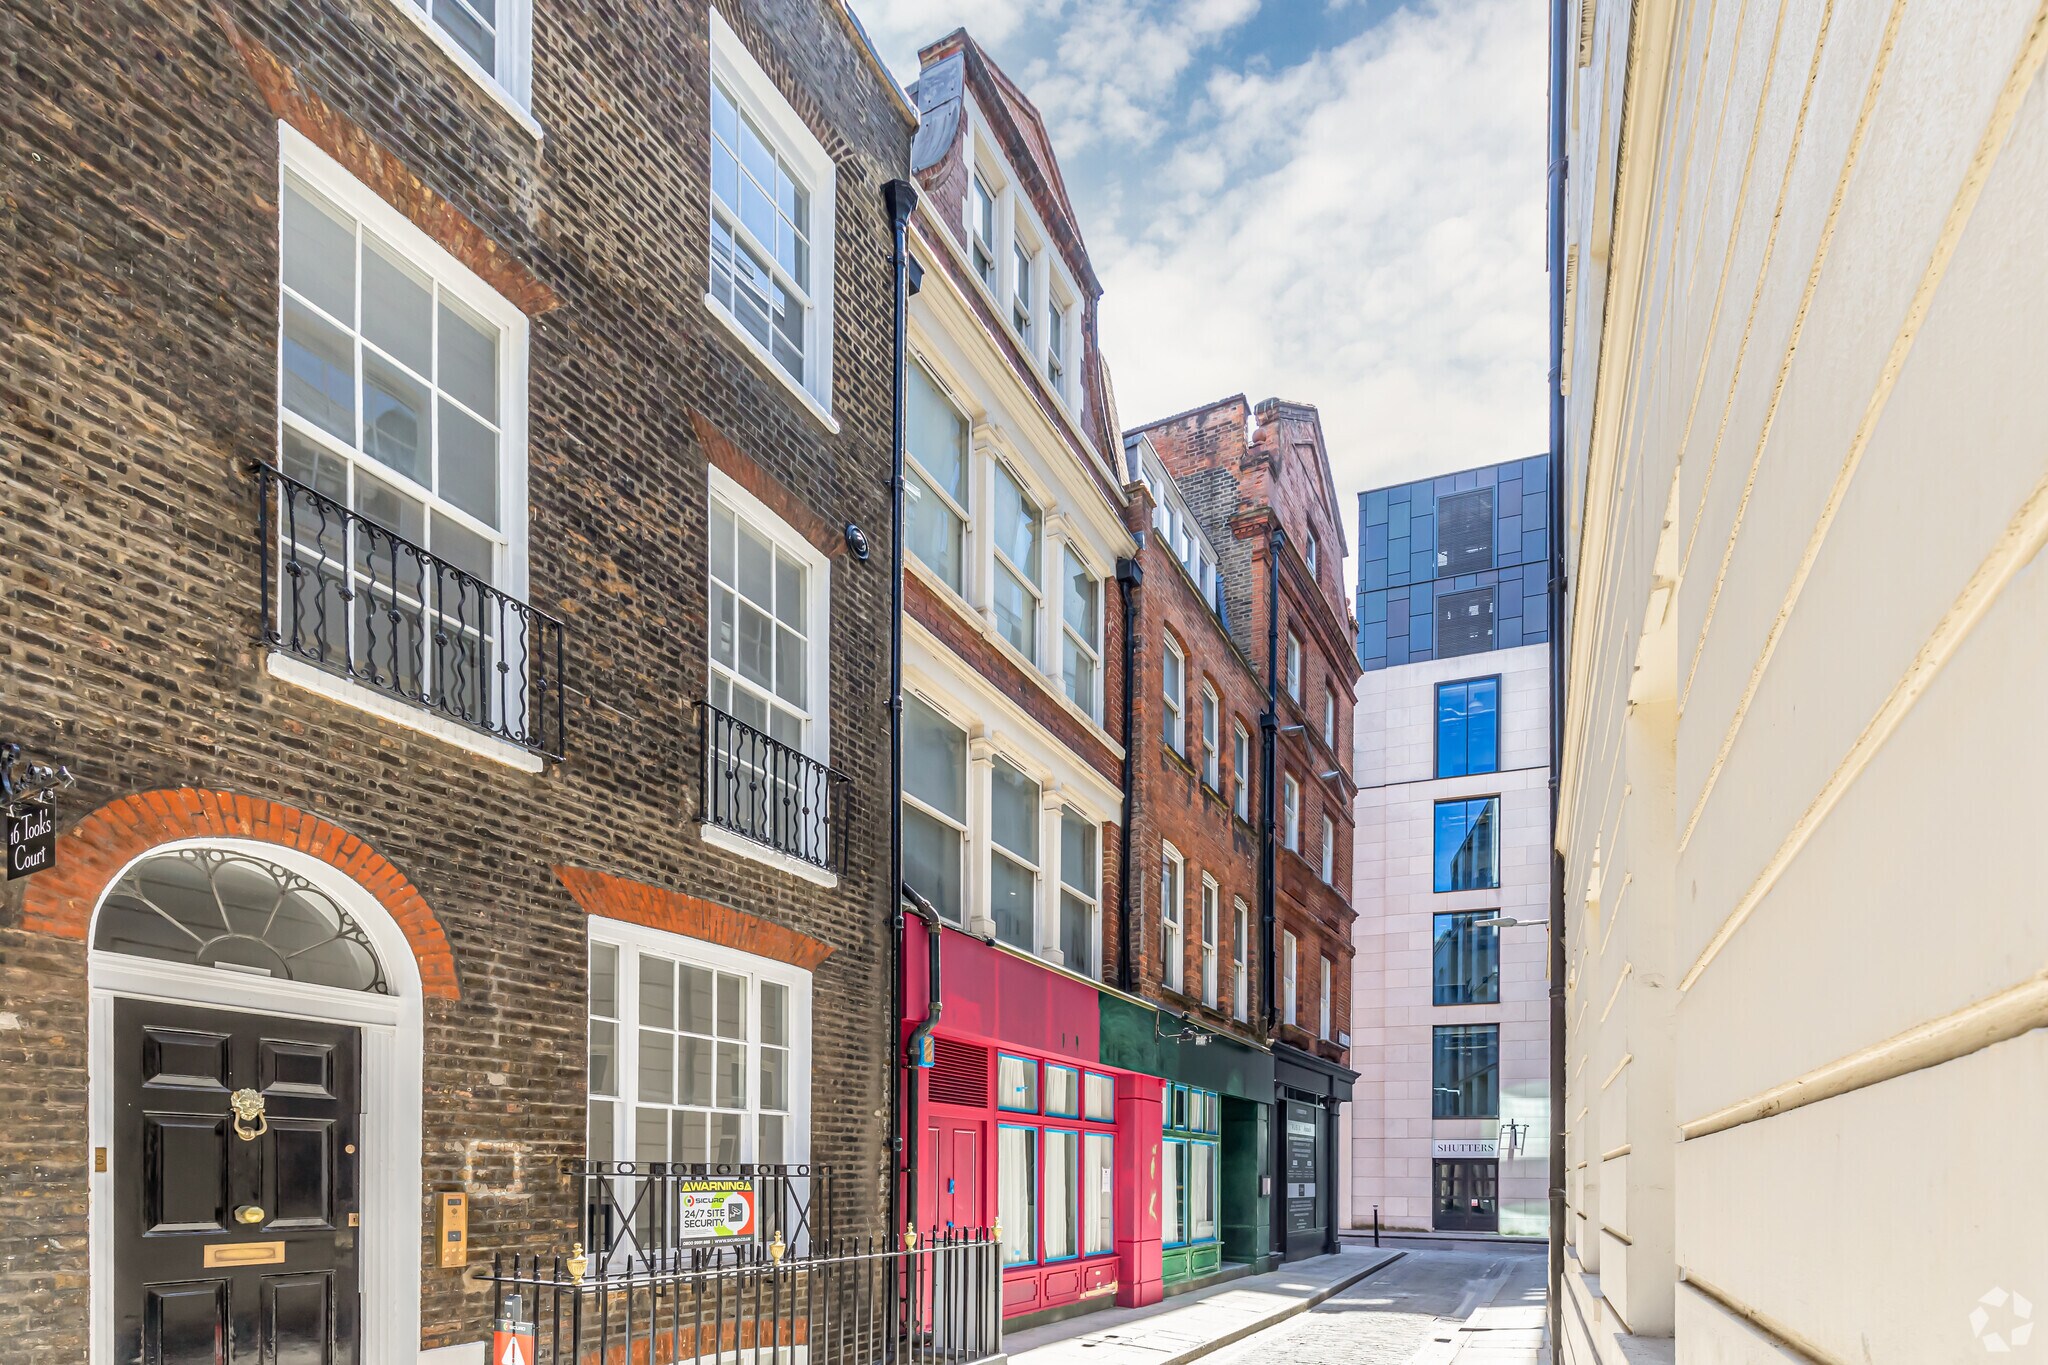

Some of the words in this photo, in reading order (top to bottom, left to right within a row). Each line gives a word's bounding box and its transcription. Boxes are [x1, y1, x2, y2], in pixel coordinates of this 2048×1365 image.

[10, 822, 20, 845] 16
[21, 808, 52, 841] Took's
[14, 844, 46, 871] Court
[1437, 1144, 1494, 1152] SHUTTERS
[690, 1181, 745, 1191] WARNING
[684, 1209, 705, 1219] 24/7
[706, 1209, 726, 1218] SITE
[684, 1219, 725, 1228] SECURITY
